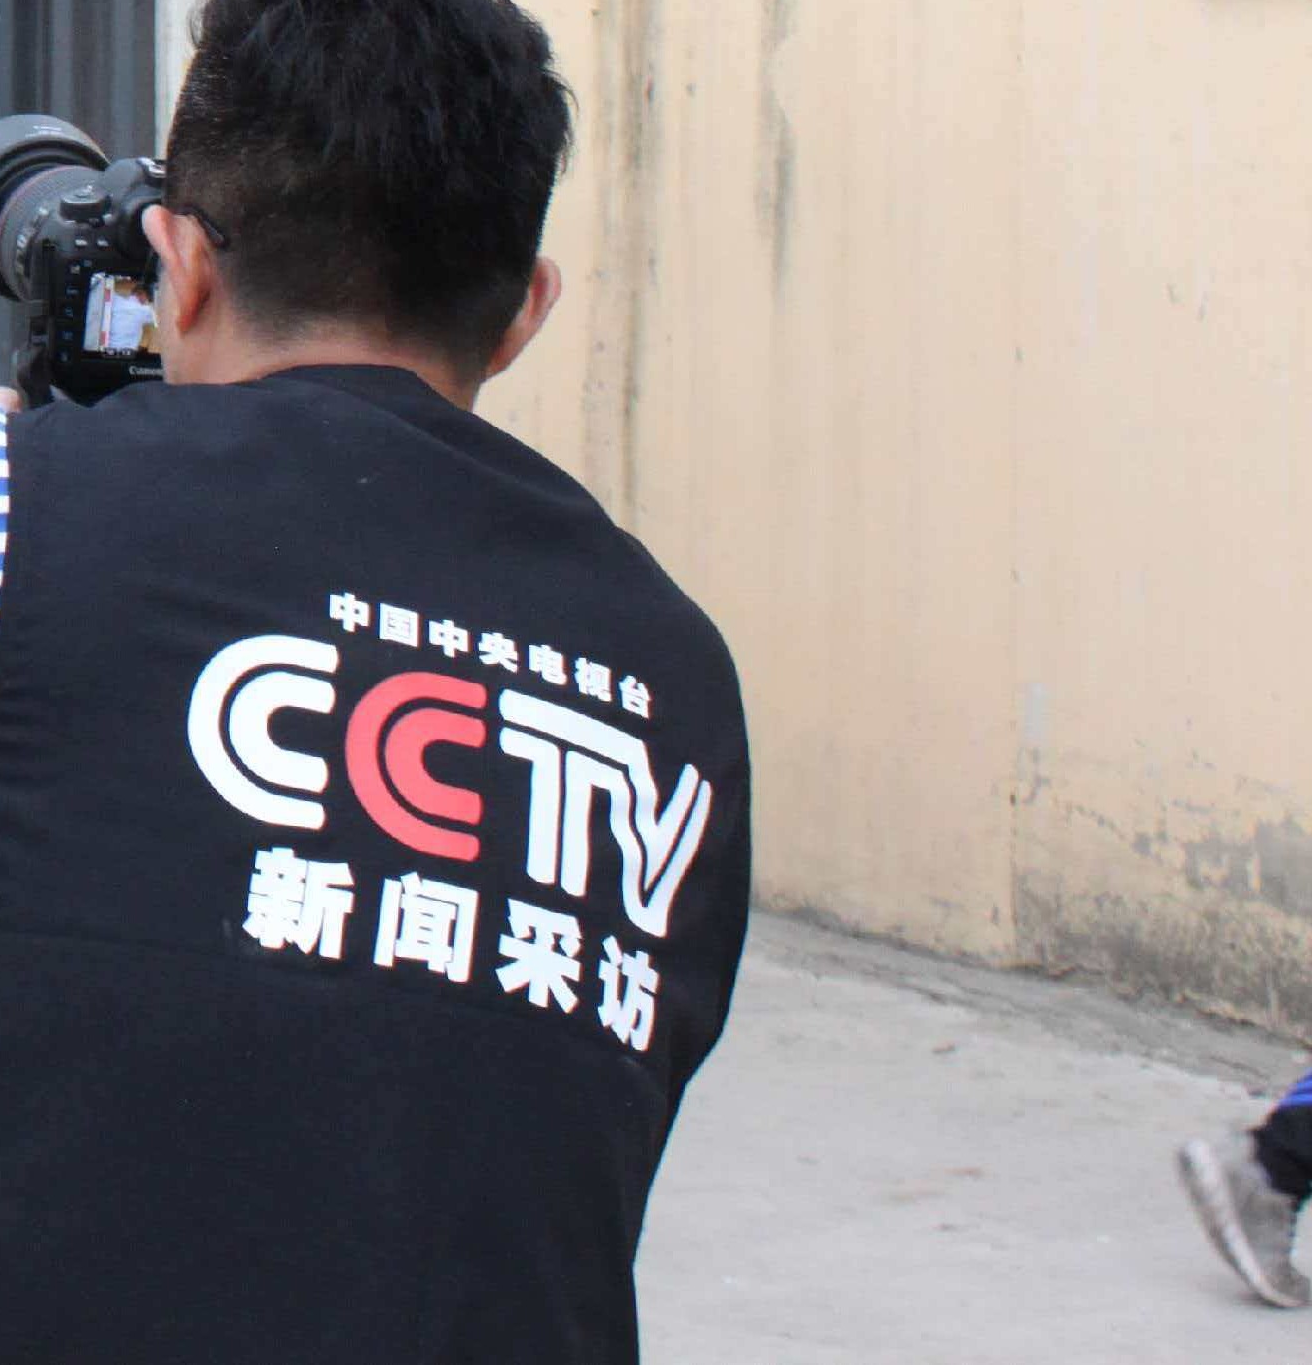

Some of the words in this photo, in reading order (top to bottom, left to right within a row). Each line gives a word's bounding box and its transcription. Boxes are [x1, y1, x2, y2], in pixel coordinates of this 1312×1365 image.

[329, 591, 651, 718] 中国中央电视台
[187, 635, 712, 937] CCTV
[243, 847, 660, 1051] 新闻采访
